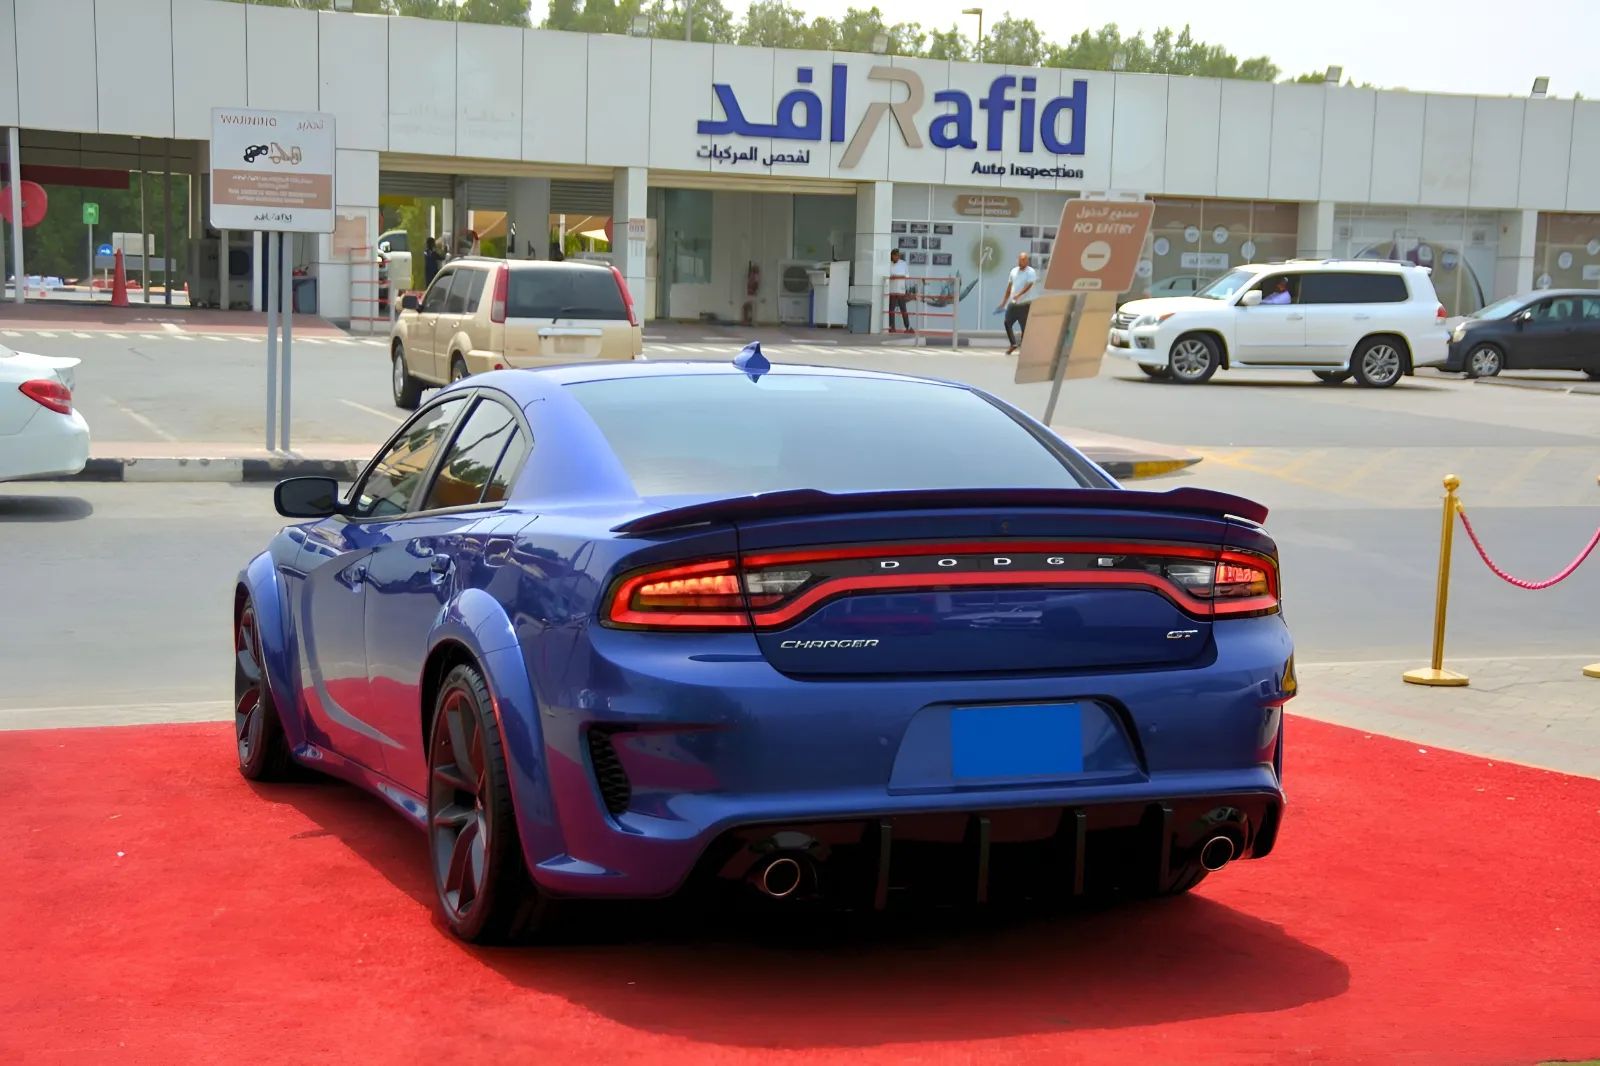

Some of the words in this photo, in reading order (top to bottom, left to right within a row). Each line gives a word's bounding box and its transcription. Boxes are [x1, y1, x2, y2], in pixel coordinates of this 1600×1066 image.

[838, 66, 1088, 168] Rafid
[697, 144, 758, 165] المركبات
[971, 161, 1006, 175] Auto
[1010, 163, 1084, 179] Inspection
[880, 556, 1114, 569] DODGE
[1166, 629, 1199, 639] GT
[780, 639, 880, 649] CHARGER
